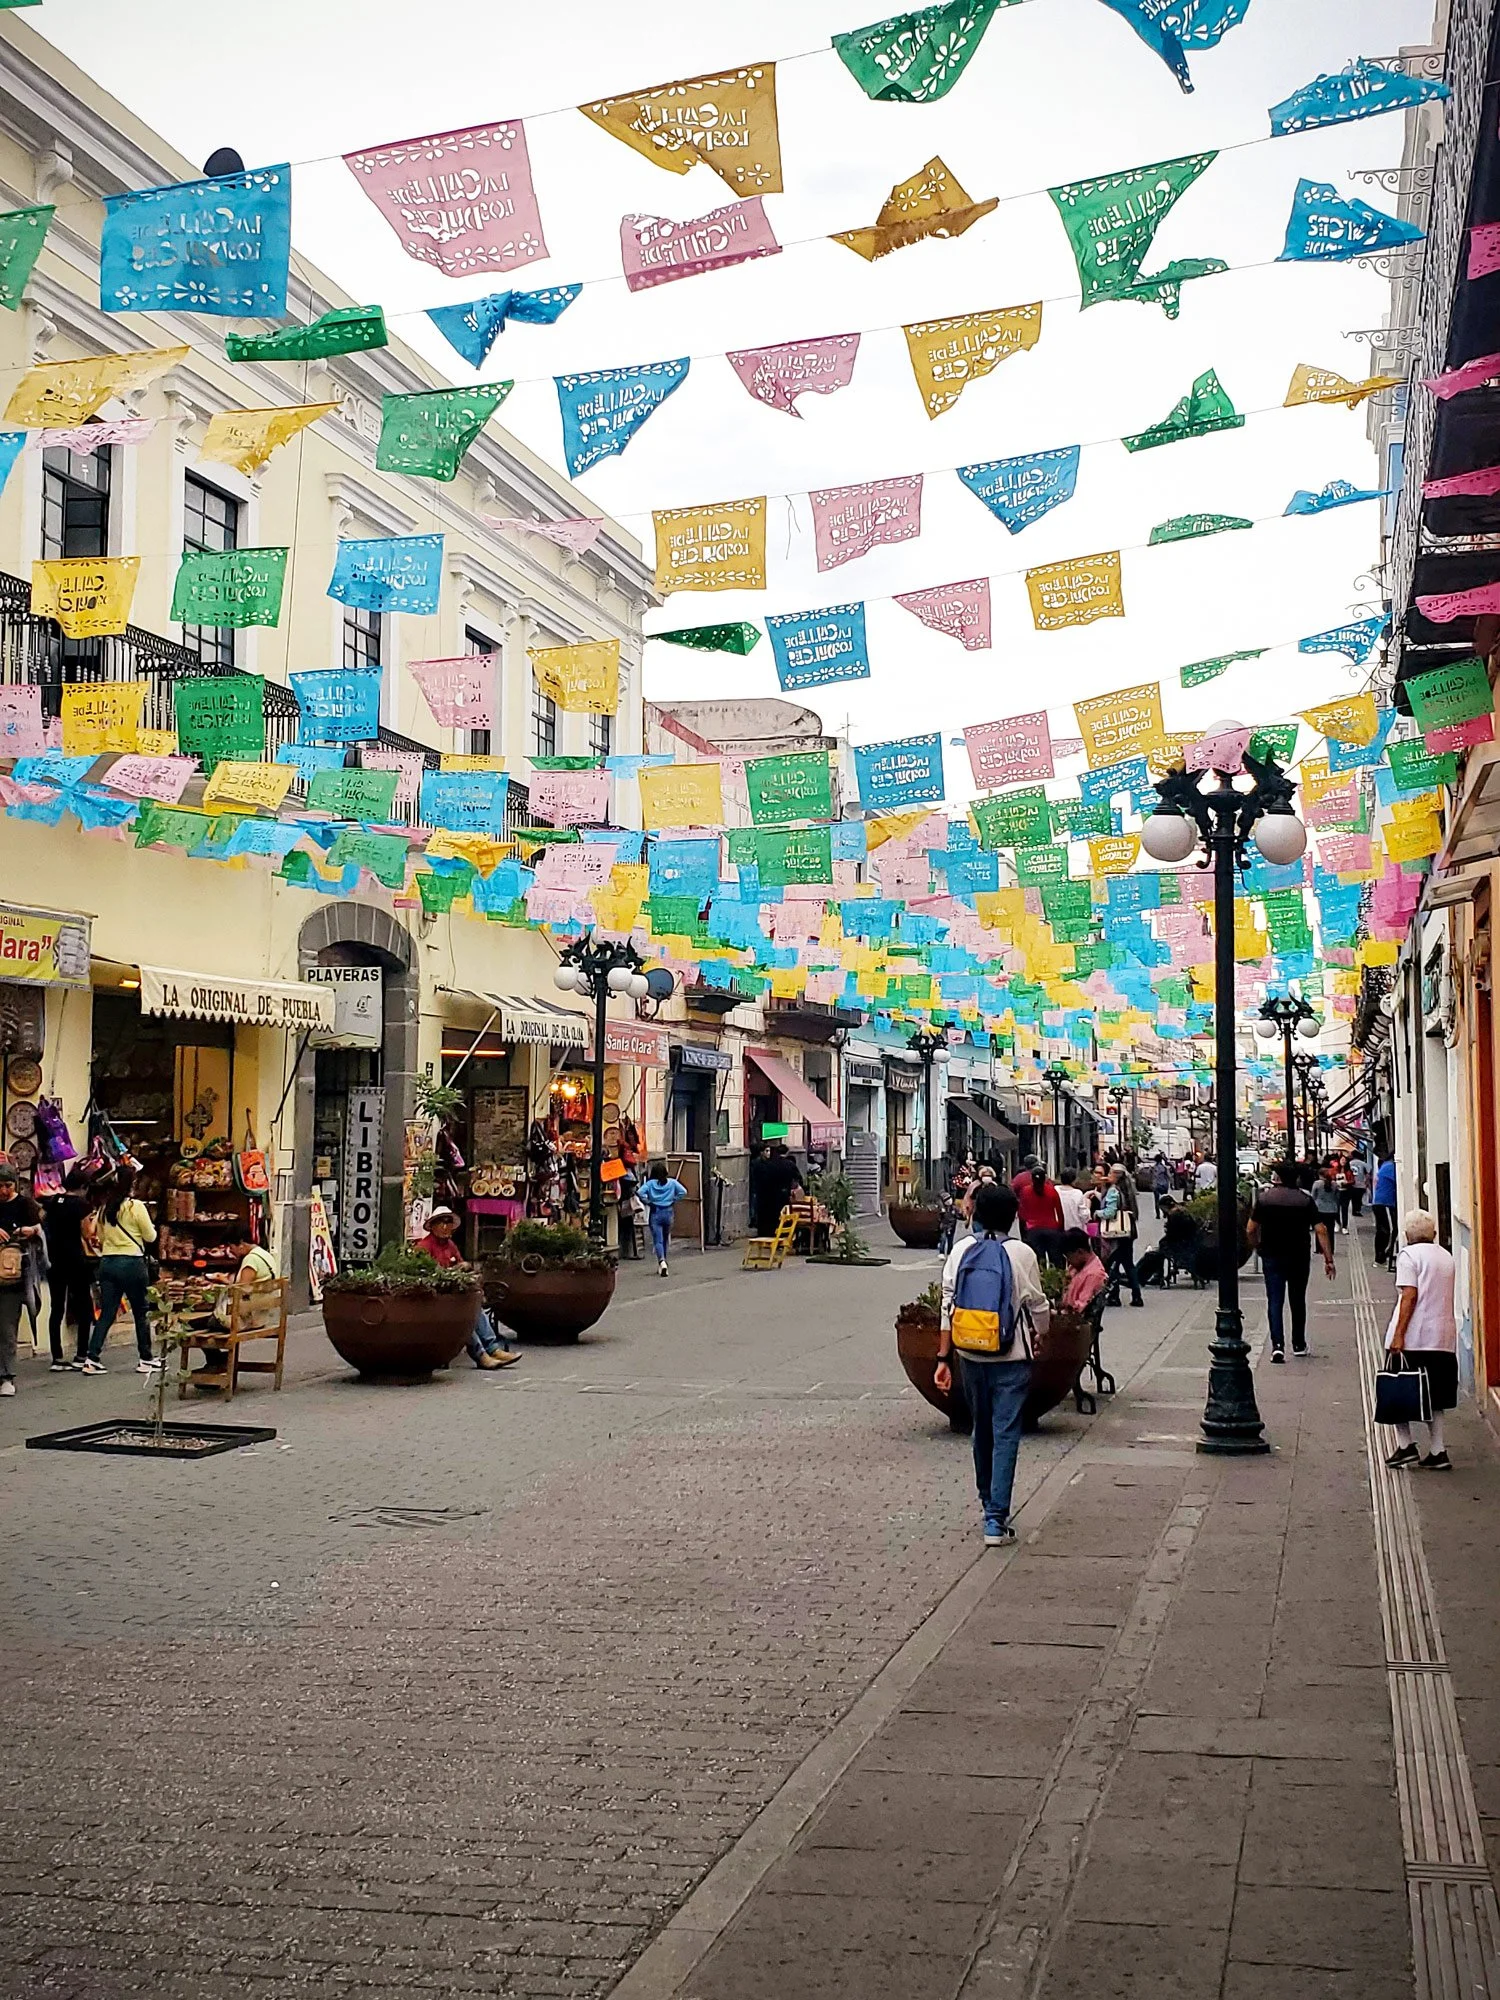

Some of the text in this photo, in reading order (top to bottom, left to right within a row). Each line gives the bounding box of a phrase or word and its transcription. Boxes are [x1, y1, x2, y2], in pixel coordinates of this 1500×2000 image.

[786, 844, 809, 856] ALLE
[1104, 842, 1129, 851] CALLE
[1031, 854, 1053, 865] CALLE
[1035, 862, 1062, 874] DULCES
[308, 968, 379, 982] PLAYERAS
[163, 984, 321, 1021] LA ORIGINAL DE PUEBLA
[506, 1019, 515, 1035] LA
[520, 1021, 549, 1038] ORIGINAL
[551, 1024, 560, 1039] DE
[352, 1101, 373, 1250] LIBROS
